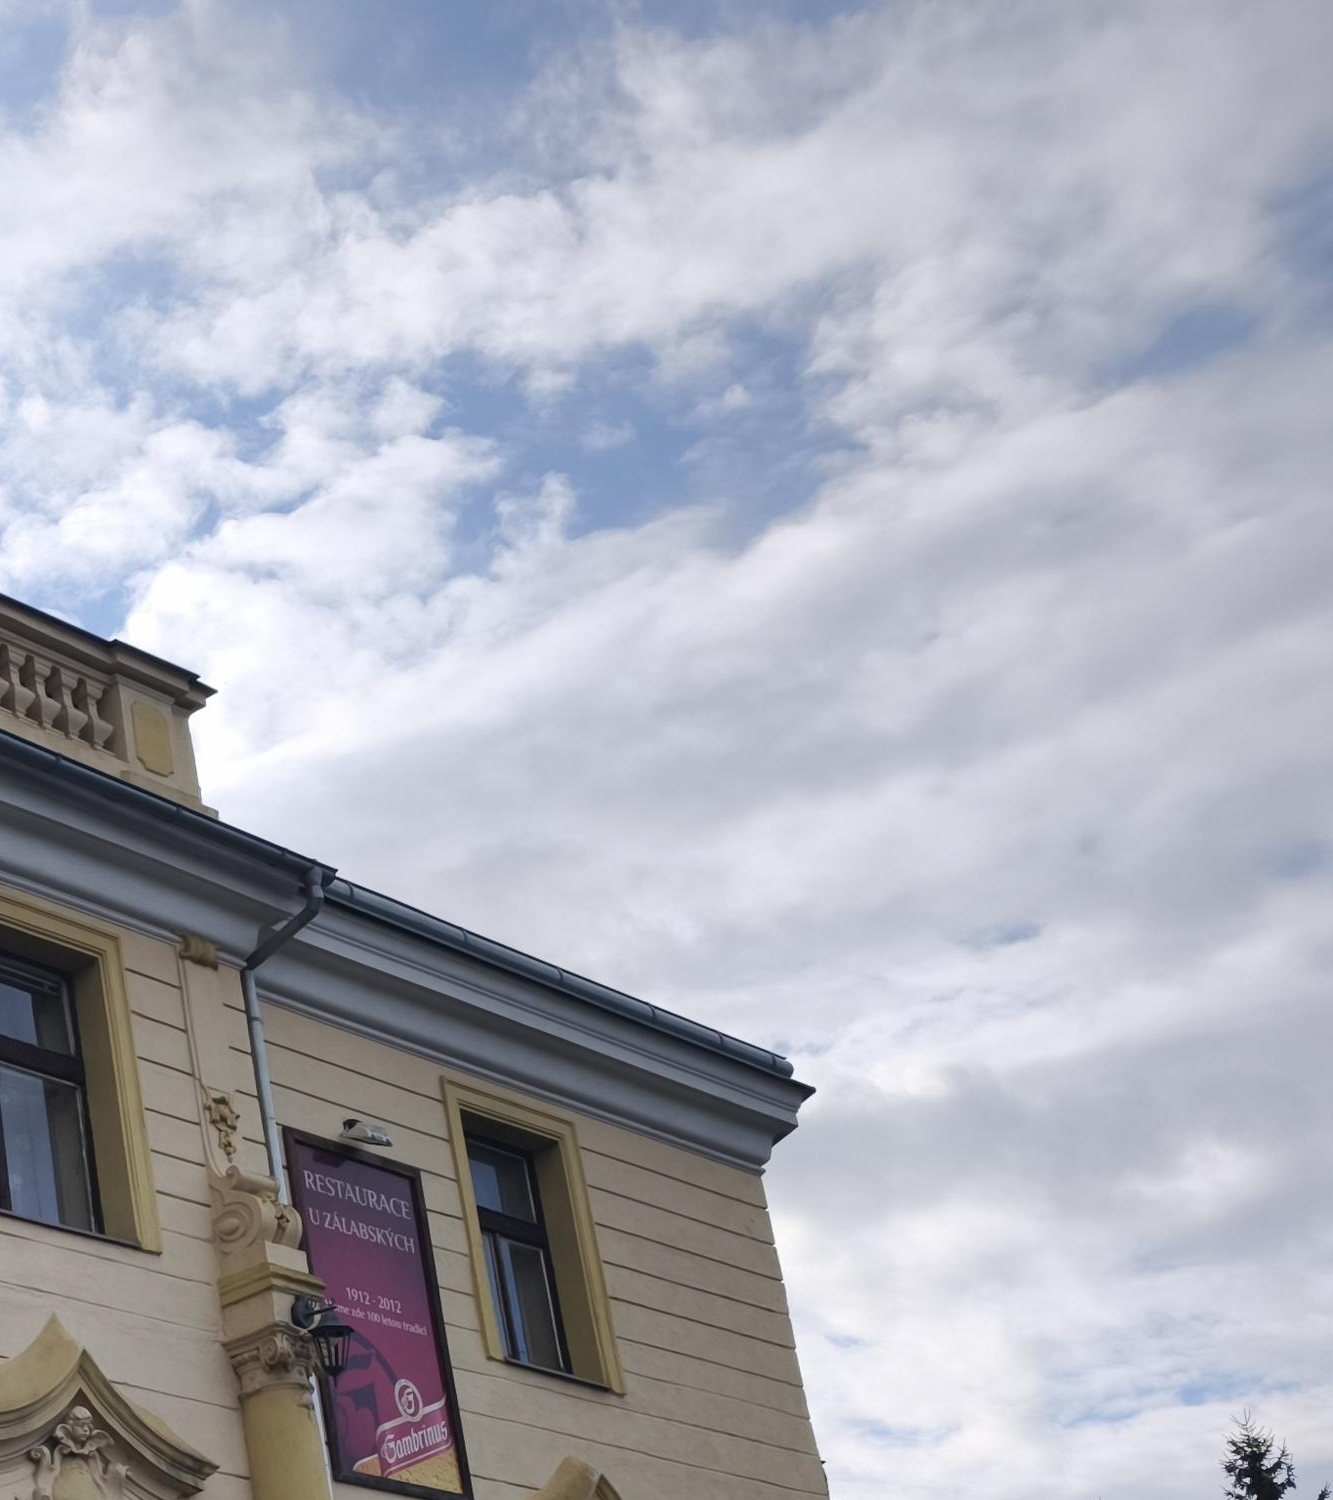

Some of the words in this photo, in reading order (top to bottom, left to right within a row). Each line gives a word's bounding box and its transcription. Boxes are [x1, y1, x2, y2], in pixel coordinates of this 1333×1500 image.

[303, 1170, 412, 1220] RESTAURACE
[309, 1207, 321, 1225] U
[324, 1210, 416, 1254] ZÁLABSKÝCH
[345, 1287, 371, 1305] 1912
[378, 1295, 402, 1314] 2012
[381, 1420, 448, 1464] Gambrinus
